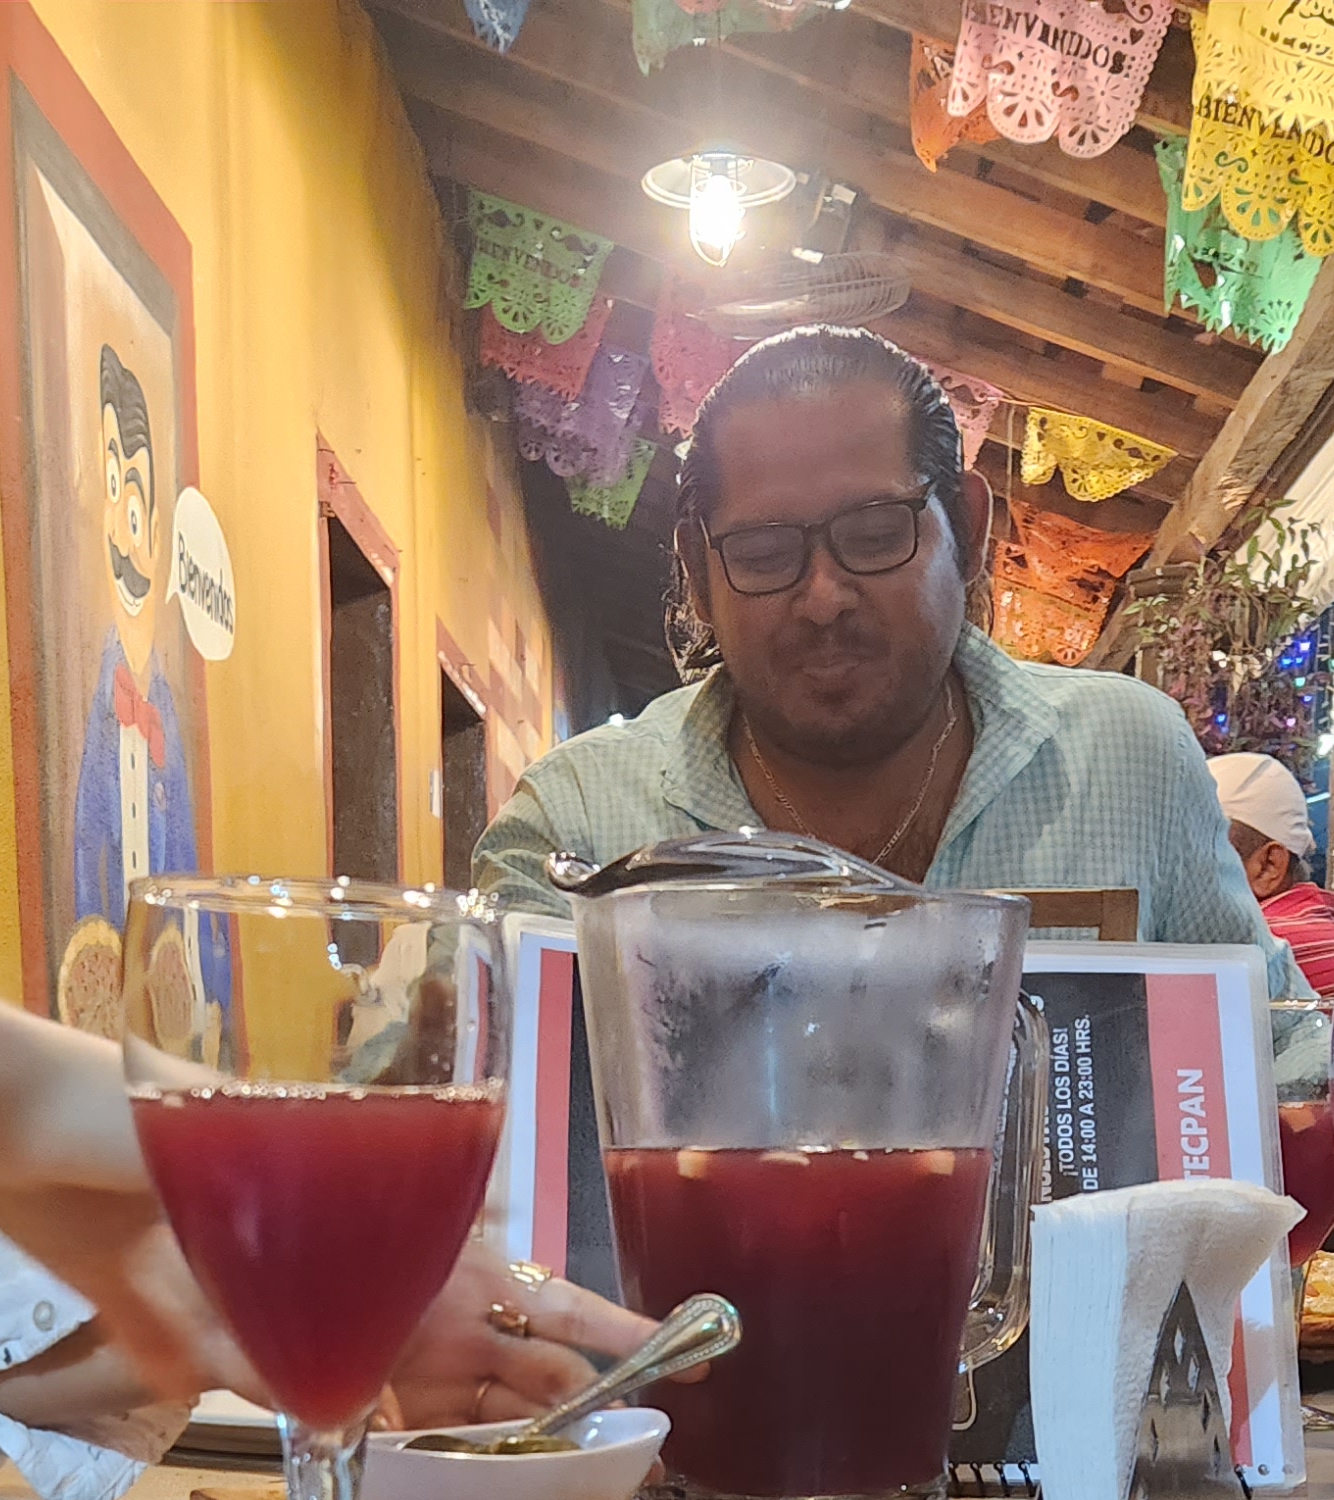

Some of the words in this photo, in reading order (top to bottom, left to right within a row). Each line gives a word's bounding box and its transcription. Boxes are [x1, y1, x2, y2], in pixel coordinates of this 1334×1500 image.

[178, 530, 234, 635] Bienvenidos
[1050, 1027, 1071, 1072] DÍAS!
[1074, 1014, 1092, 1053] HRS.
[1054, 1077, 1072, 1109] LOS
[1077, 1056, 1094, 1099] 23:00
[1079, 1102, 1095, 1117] A
[1055, 1113, 1078, 1177] ¡TODOS
[1079, 1118, 1097, 1162] 14:00
[1083, 1165, 1099, 1190] DE
